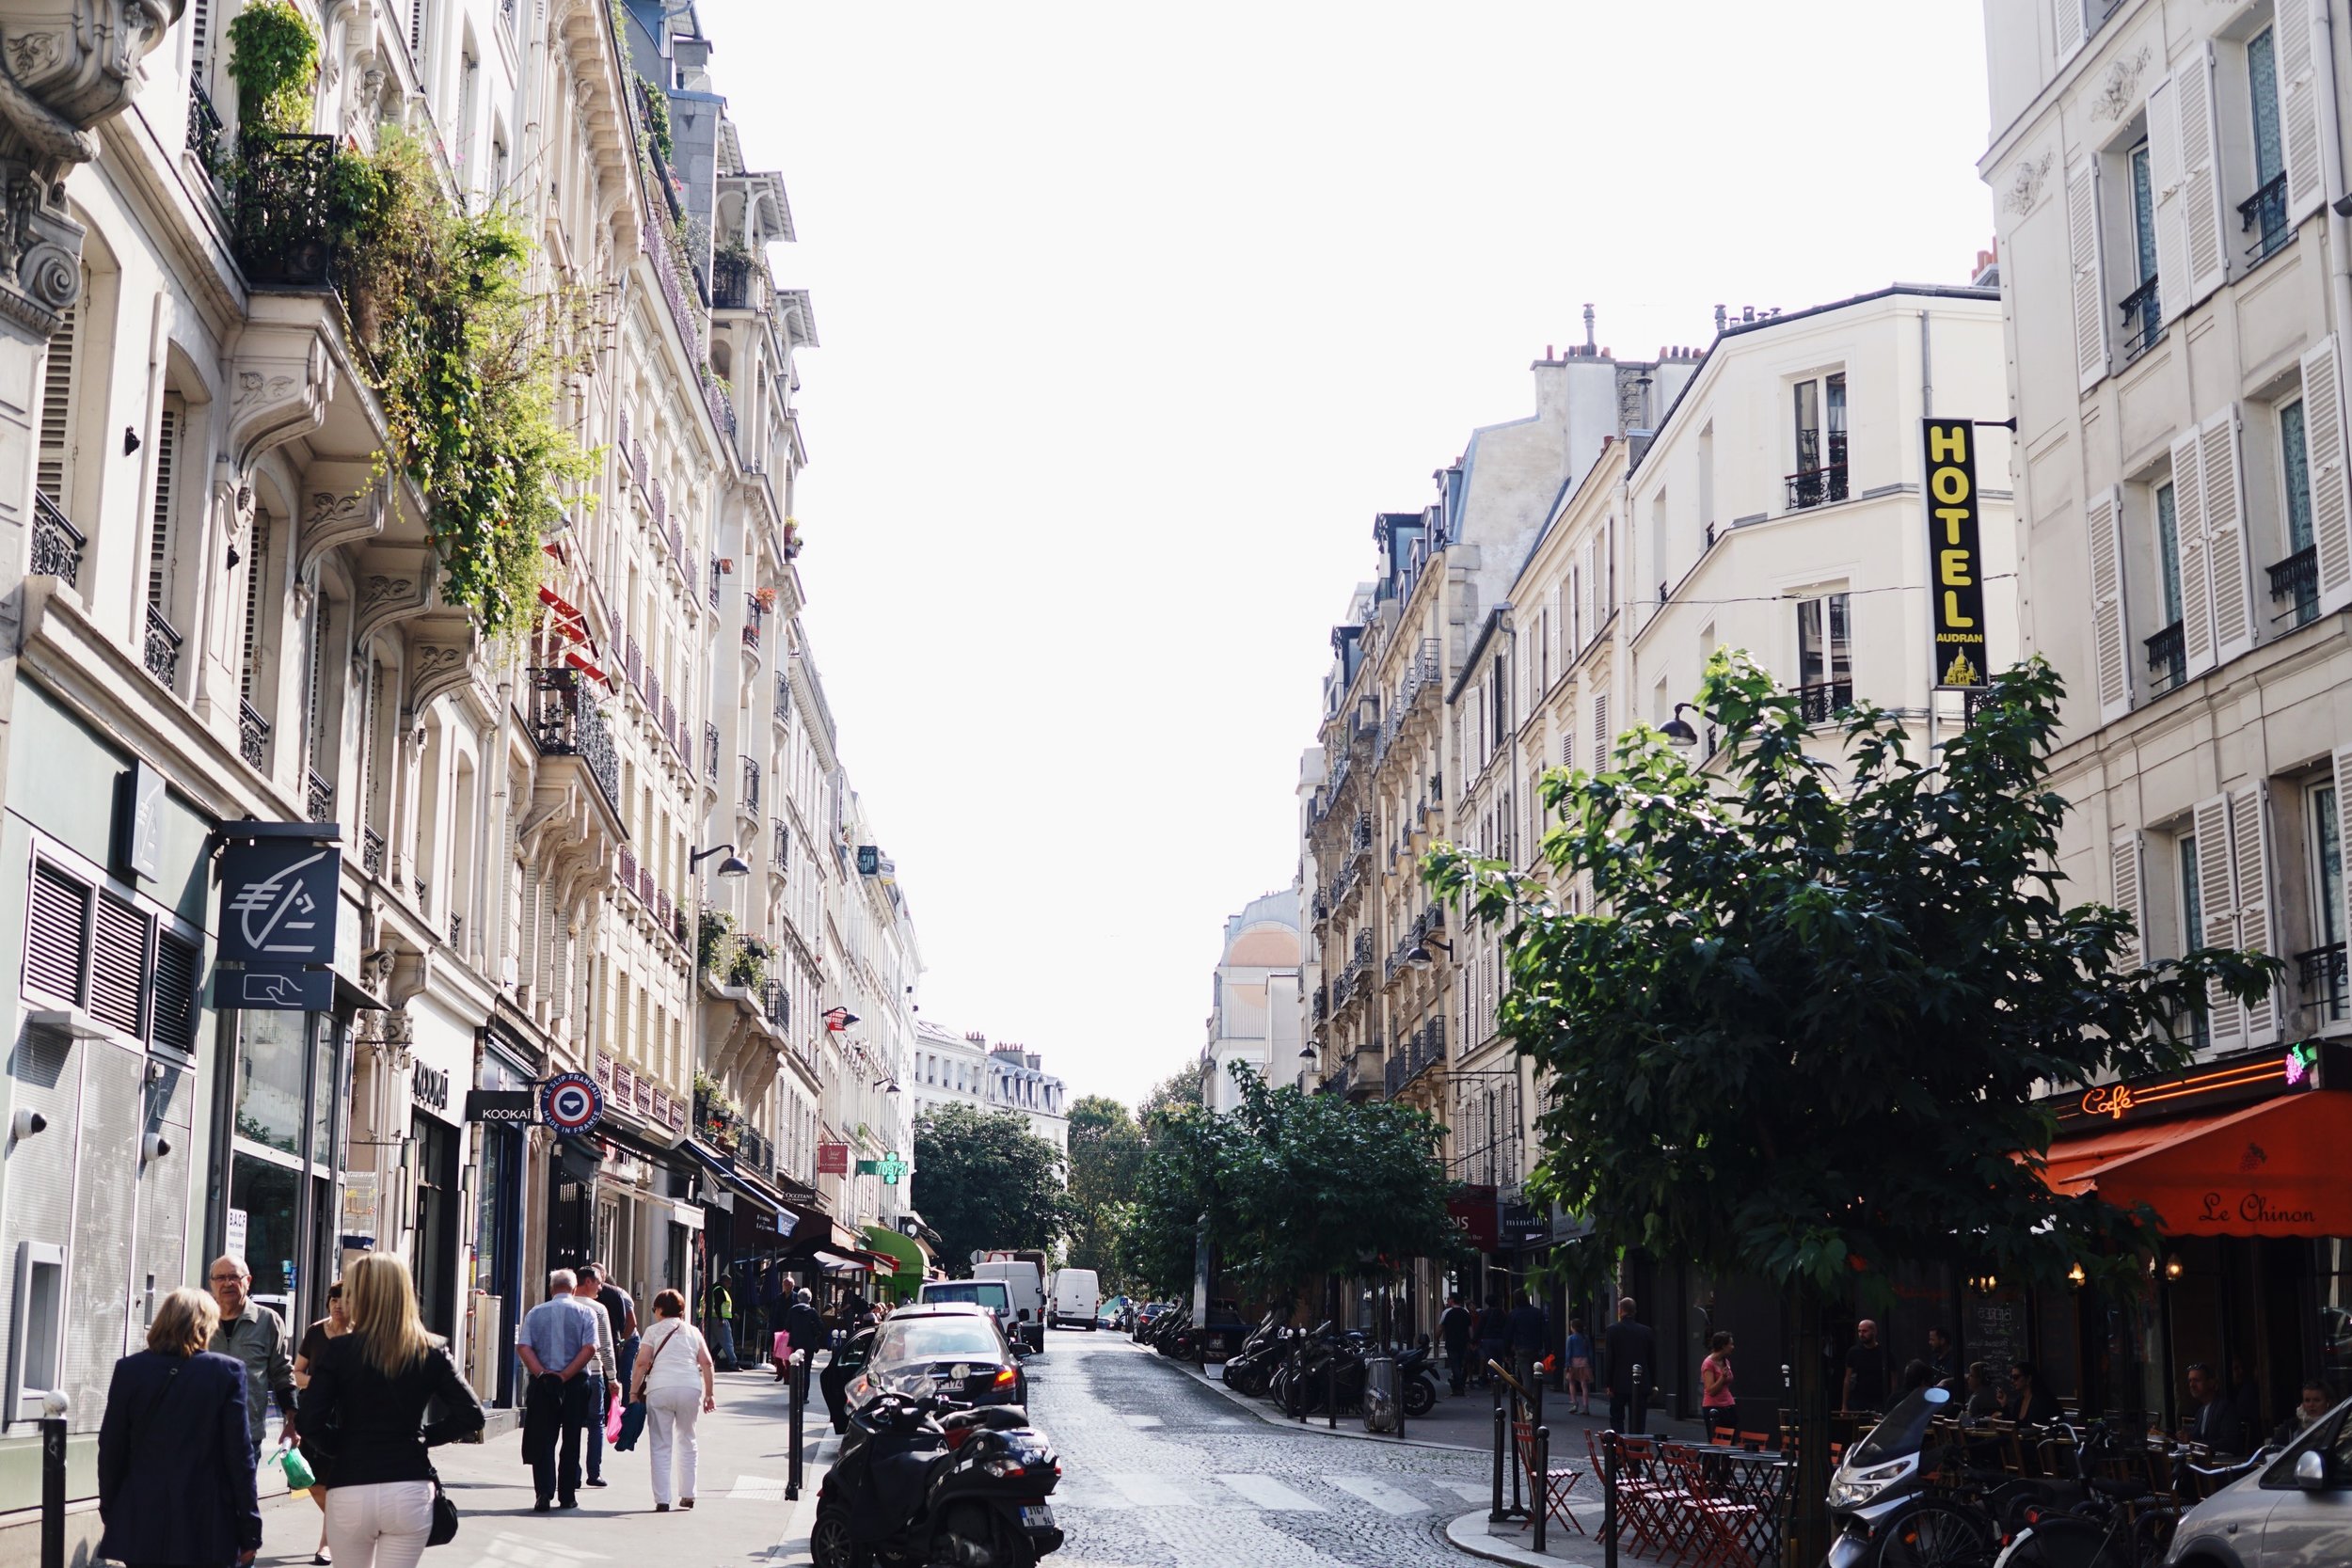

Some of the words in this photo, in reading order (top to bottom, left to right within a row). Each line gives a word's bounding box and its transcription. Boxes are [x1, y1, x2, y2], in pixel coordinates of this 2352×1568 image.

[1931, 426, 1973, 627] HOTEL
[1936, 633, 1983, 643] AUDRAN
[543, 1089, 551, 1099] LE
[549, 1075, 566, 1088] SLIP
[568, 1074, 601, 1100] FRANÇAIS
[2082, 1085, 2134, 1118] Café
[483, 1109, 532, 1119] KOOKAÏ
[543, 1110, 560, 1130] MADE
[573, 1110, 600, 1133] FRANCE
[2199, 1193, 2231, 1221] Le
[2240, 1193, 2316, 1222] Chinon
[1506, 1217, 1543, 1226] minelli
